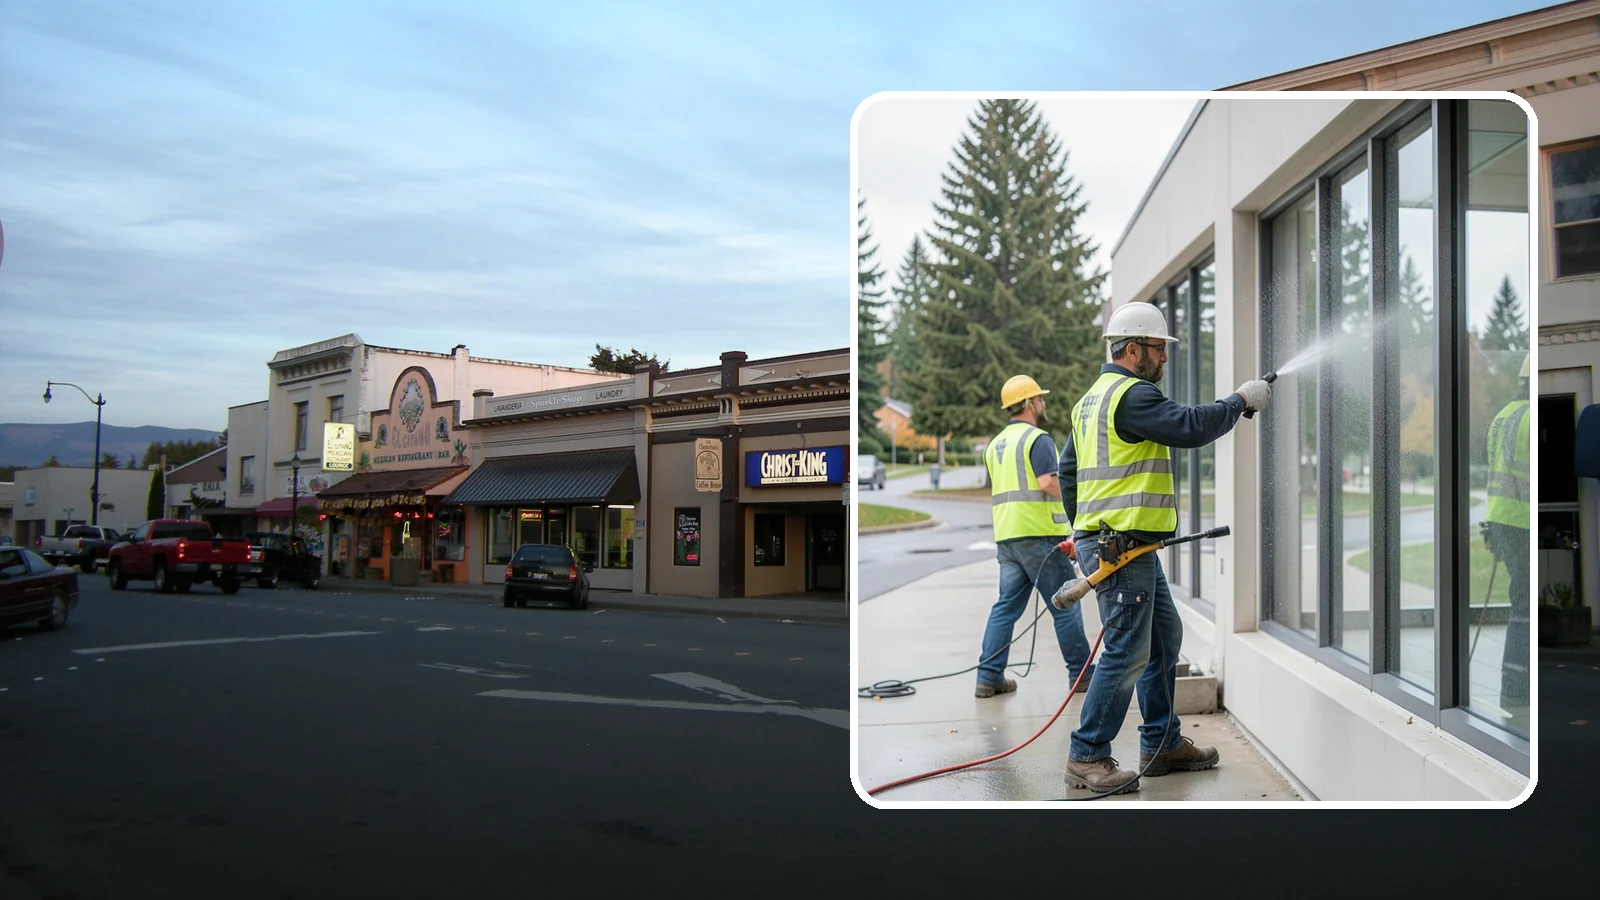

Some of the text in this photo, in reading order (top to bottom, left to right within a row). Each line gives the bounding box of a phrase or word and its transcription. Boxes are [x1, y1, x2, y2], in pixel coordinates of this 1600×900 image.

[595, 389, 624, 399] LAUNDRY
[494, 402, 522, 412] LAVANDERIA
[531, 394, 582, 409] Sparkle Shop
[374, 455, 396, 464] MEXICAN
[397, 451, 433, 462] RESTAURANT
[437, 450, 450, 459] BAR
[761, 450, 827, 478] CHRIST KING
